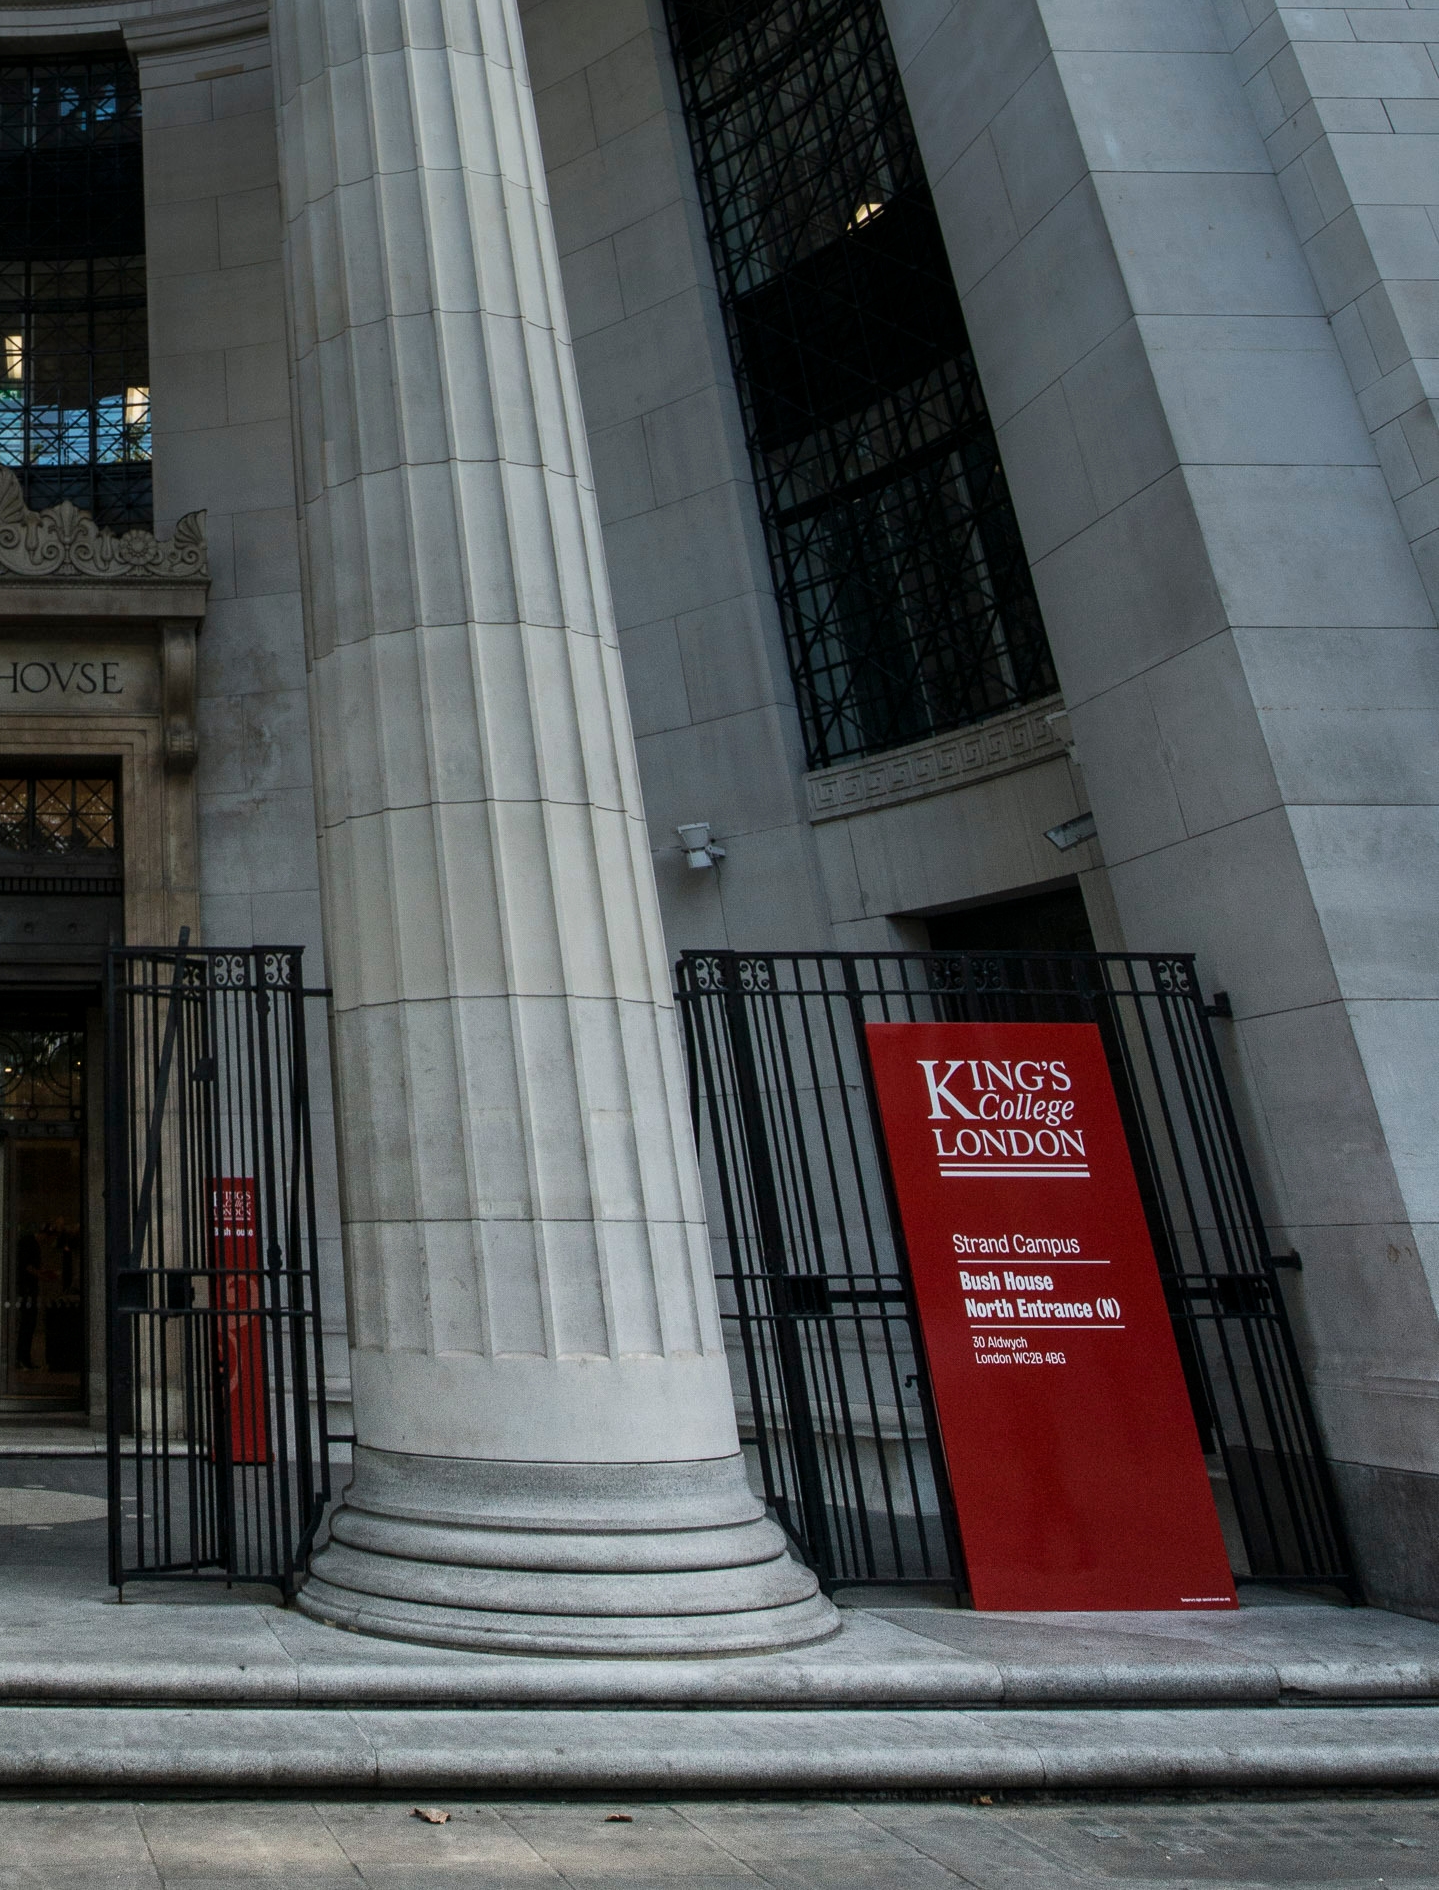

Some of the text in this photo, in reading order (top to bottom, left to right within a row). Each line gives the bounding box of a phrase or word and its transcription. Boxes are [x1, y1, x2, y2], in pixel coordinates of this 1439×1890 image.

[916, 1059, 1072, 1120] KING'S
[978, 1093, 1075, 1127] College
[931, 1128, 1087, 1157] LONDON
[952, 1233, 1081, 1258] Strand Campus
[959, 1270, 1054, 1291] Bush House
[964, 1297, 1121, 1320] North Entrance (N)
[972, 1336, 1028, 1351] 30 Aldwych
[975, 1352, 1067, 1365] London WC2B 4BG
